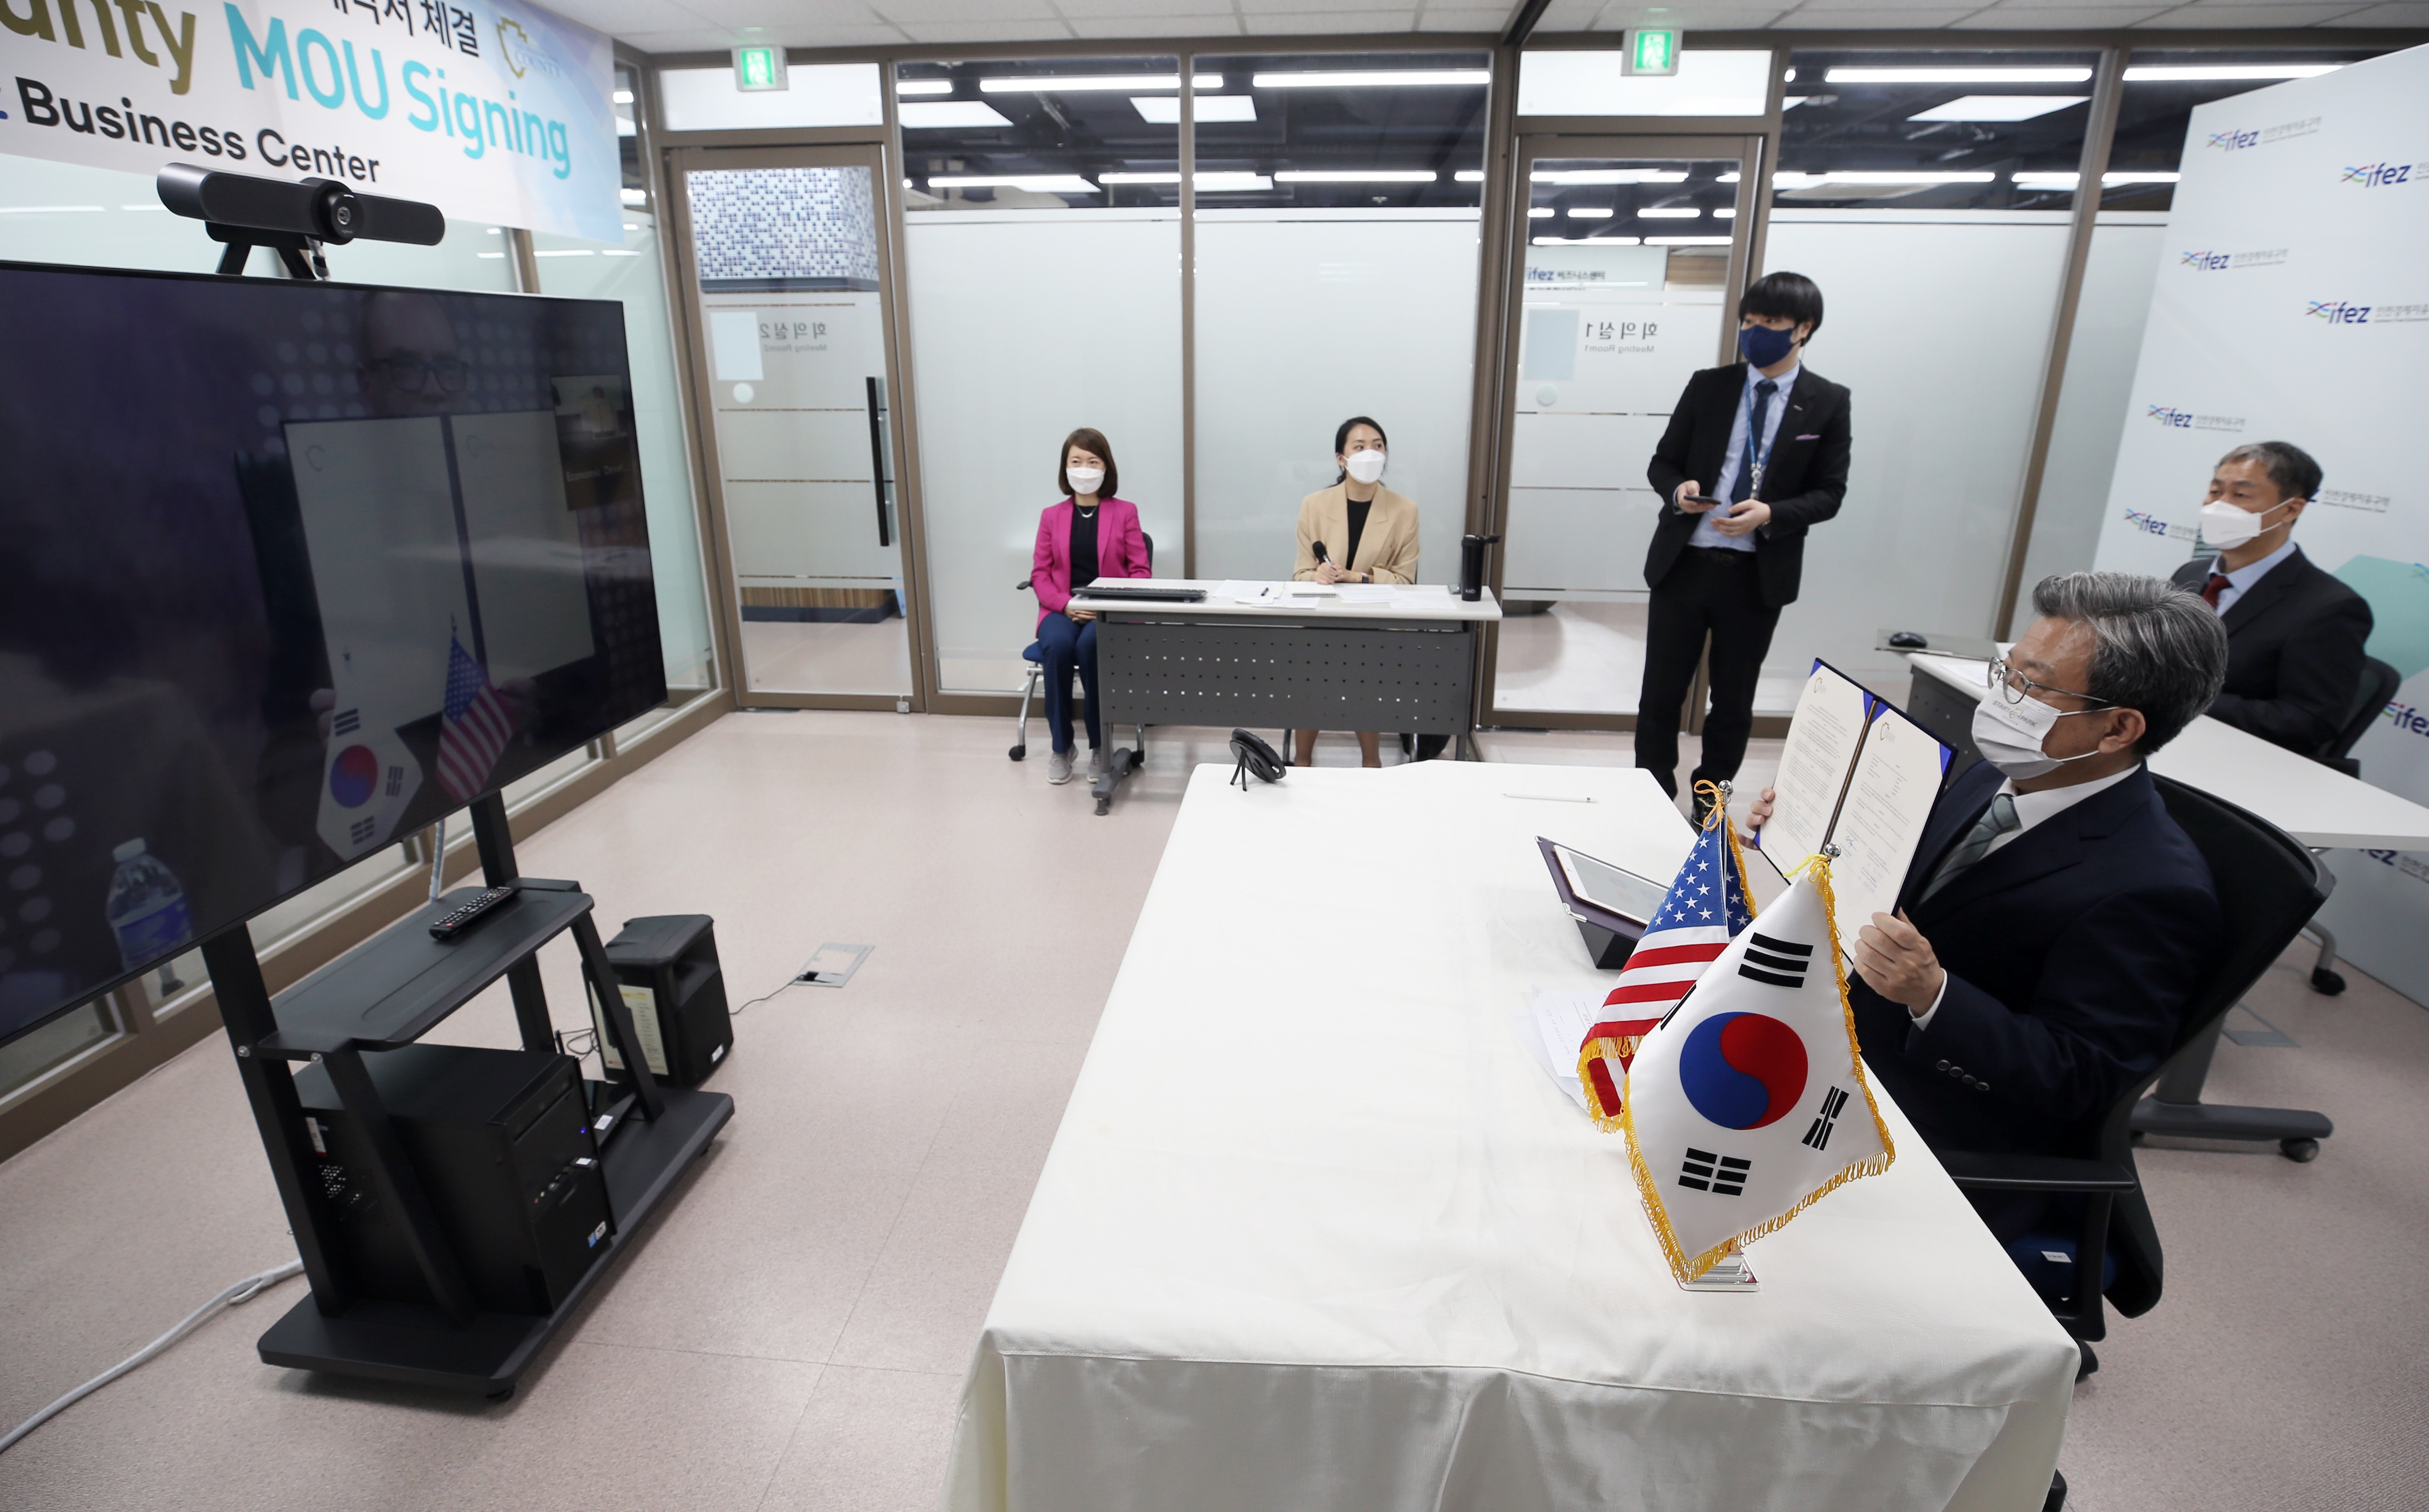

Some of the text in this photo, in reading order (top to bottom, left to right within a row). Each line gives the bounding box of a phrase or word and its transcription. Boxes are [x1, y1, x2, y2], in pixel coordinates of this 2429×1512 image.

[420, 0, 479, 57] 체결
[224, 2, 389, 119] MOU
[403, 60, 571, 179] Signing
[15, 76, 246, 160] Business
[257, 129, 379, 182] Center
[2224, 129, 2260, 151] ifez
[2365, 163, 2412, 187] ifez
[2198, 251, 2230, 271] ifez
[2329, 302, 2372, 323] ifez
[2163, 408, 2193, 428] ifez
[2139, 514, 2168, 535] ifez
[2394, 704, 2429, 738] ife
